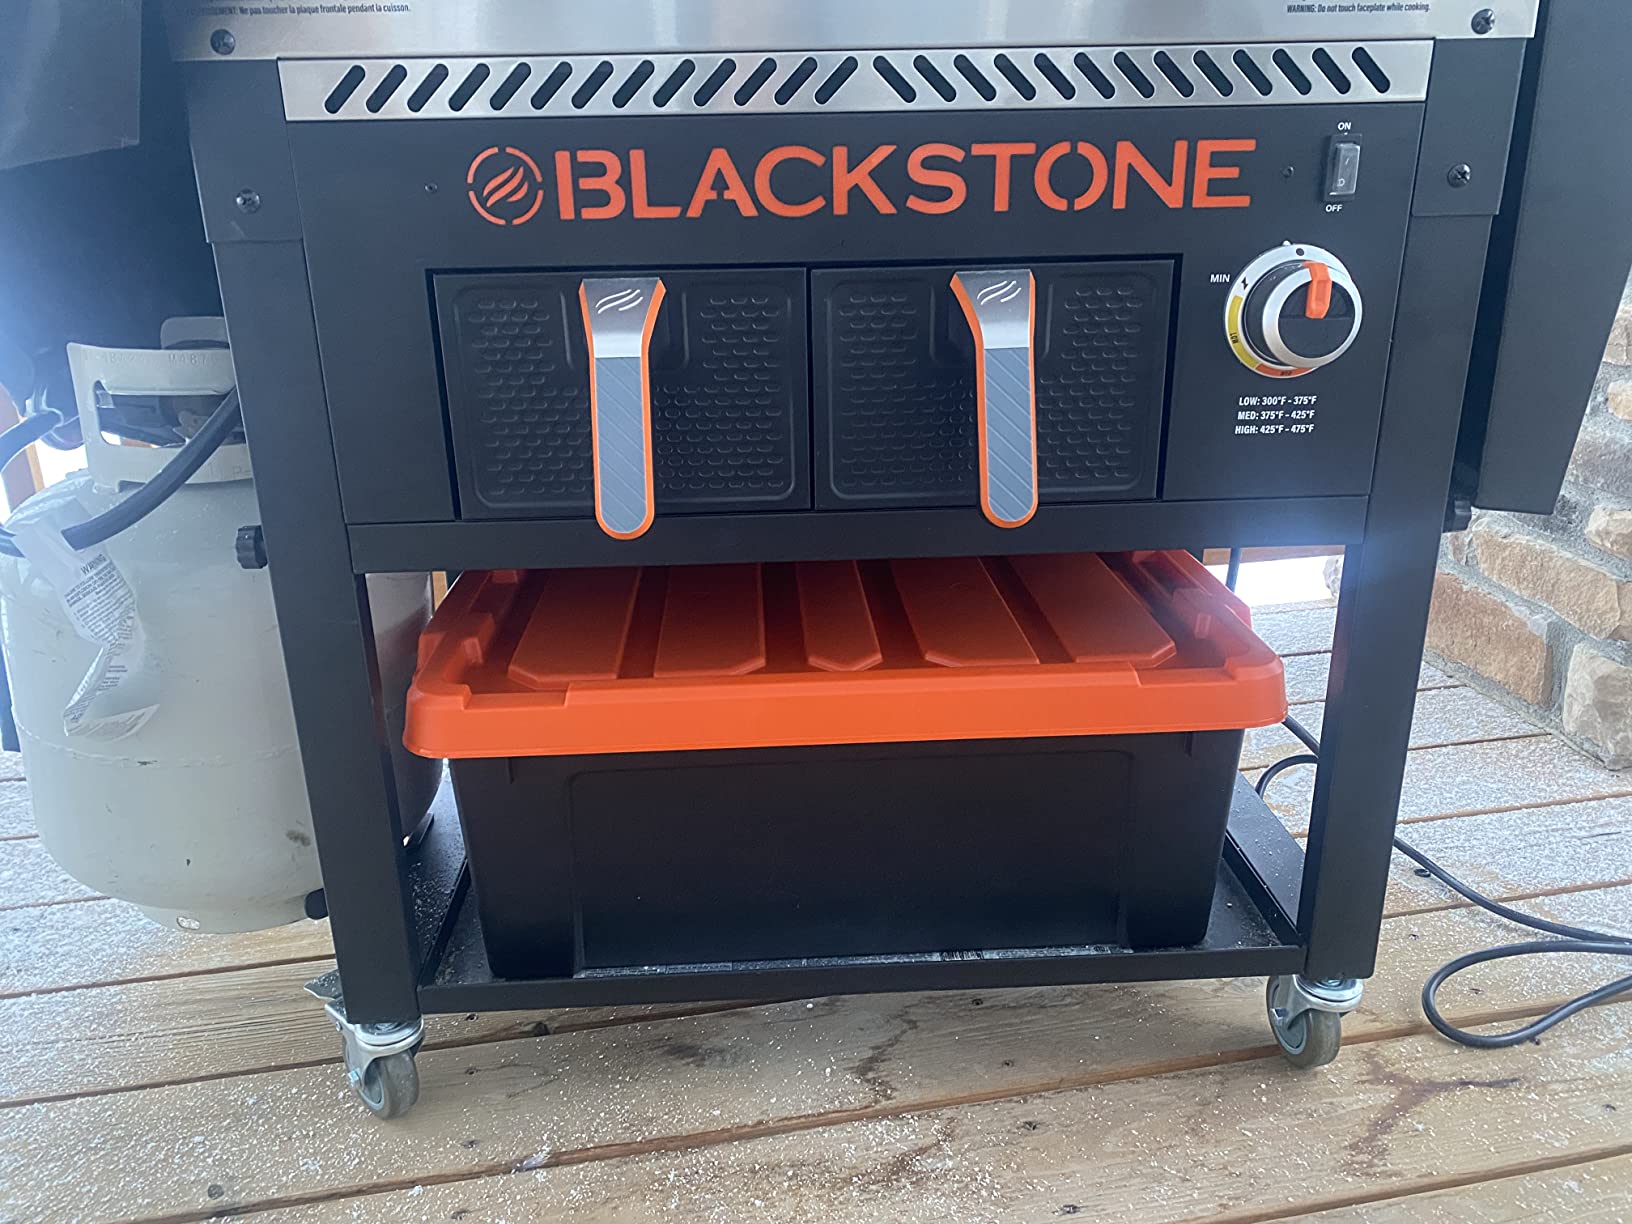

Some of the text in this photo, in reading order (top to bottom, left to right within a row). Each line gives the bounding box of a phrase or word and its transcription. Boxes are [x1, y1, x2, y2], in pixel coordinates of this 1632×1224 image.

[249, 7, 262, 16] pas
[262, 6, 288, 15] toucher
[289, 5, 296, 14] la
[296, 5, 319, 15] plaque
[320, 4, 347, 14] frontale
[347, 4, 375, 14] pendant
[375, 4, 382, 12] la
[383, 3, 411, 12] cuisson.
[1287, 2, 1430, 13] WARNING: Do not touch faceplate while cooking.
[1337, 122, 1352, 131] ON
[554, 138, 1258, 221] BLACKSTONE
[1325, 204, 1343, 213] OFF
[1210, 273, 1231, 283] MIN
[1239, 396, 1261, 406] LOW:
[1261, 396, 1287, 406] 300°F
[1293, 395, 1317, 405] 375°F
[1237, 410, 1260, 420] MED:
[1260, 410, 1285, 420] 375°F
[1290, 409, 1315, 419] 425°F
[1234, 424, 1260, 435] HIGH:
[1259, 424, 1285, 434] 425°F
[1290, 423, 1315, 433] 475°F
